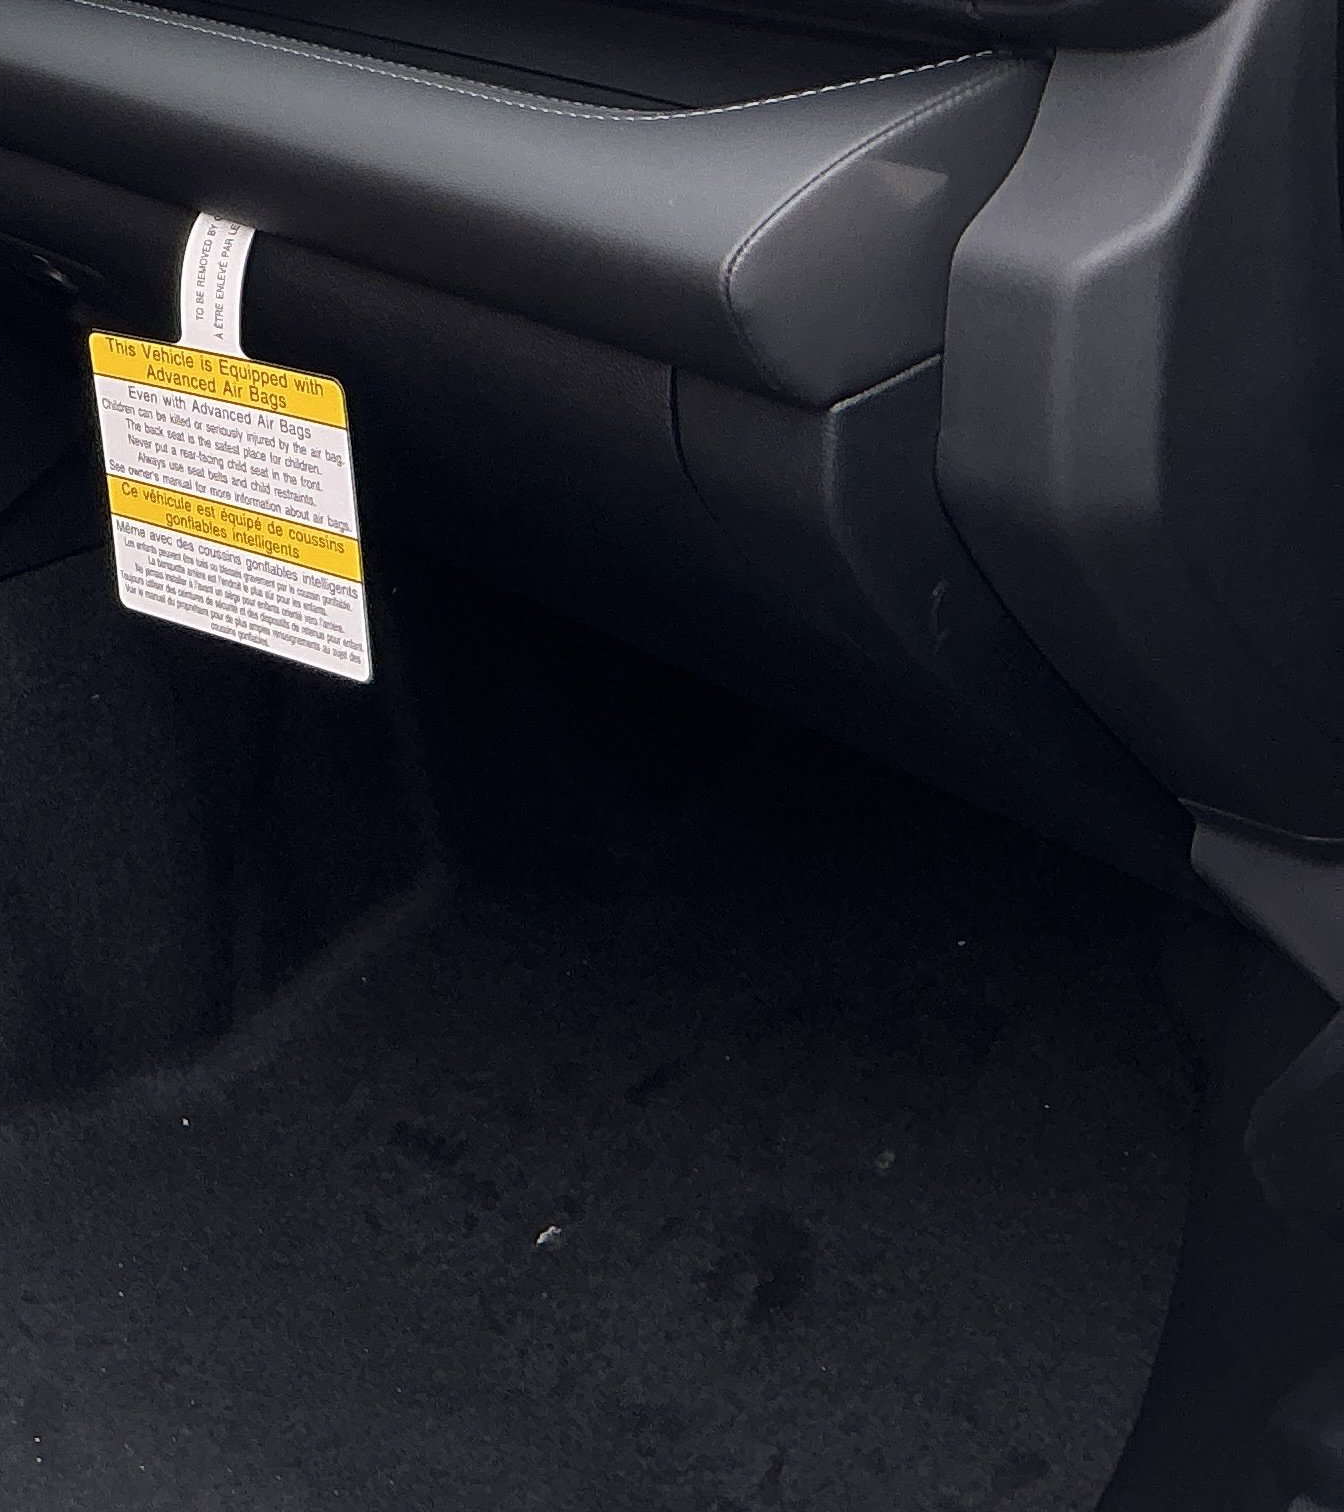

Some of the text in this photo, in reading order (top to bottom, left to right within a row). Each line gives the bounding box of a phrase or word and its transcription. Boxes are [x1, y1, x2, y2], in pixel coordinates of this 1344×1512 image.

[206, 223, 218, 236] BY
[220, 238, 235, 258] PAR
[196, 239, 213, 288] REMOVED
[215, 260, 228, 300] ENLEVÉ
[195, 290, 205, 304] BE
[195, 307, 205, 321] TO
[106, 337, 323, 396] This Vehicle is Equipped with
[147, 365, 286, 410] Advanced Air Bags
[102, 398, 135, 415] Children
[156, 410, 166, 422] be
[278, 438, 289, 454] by
[293, 442, 307, 455] the
[128, 386, 311, 440] Even with Advanced Air Bags
[125, 418, 141, 432] The
[167, 430, 185, 442] seat
[198, 436, 211, 448] the
[243, 447, 266, 461] place
[227, 460, 247, 473] child
[272, 469, 280, 481] in
[283, 472, 297, 485] the
[122, 482, 344, 553] Ce véhicule est équipé de coussins
[285, 506, 310, 521] about
[150, 532, 172, 546] avec
[176, 538, 194, 552] des
[198, 545, 241, 565] coussins
[166, 514, 299, 558] gonflables intelligents
